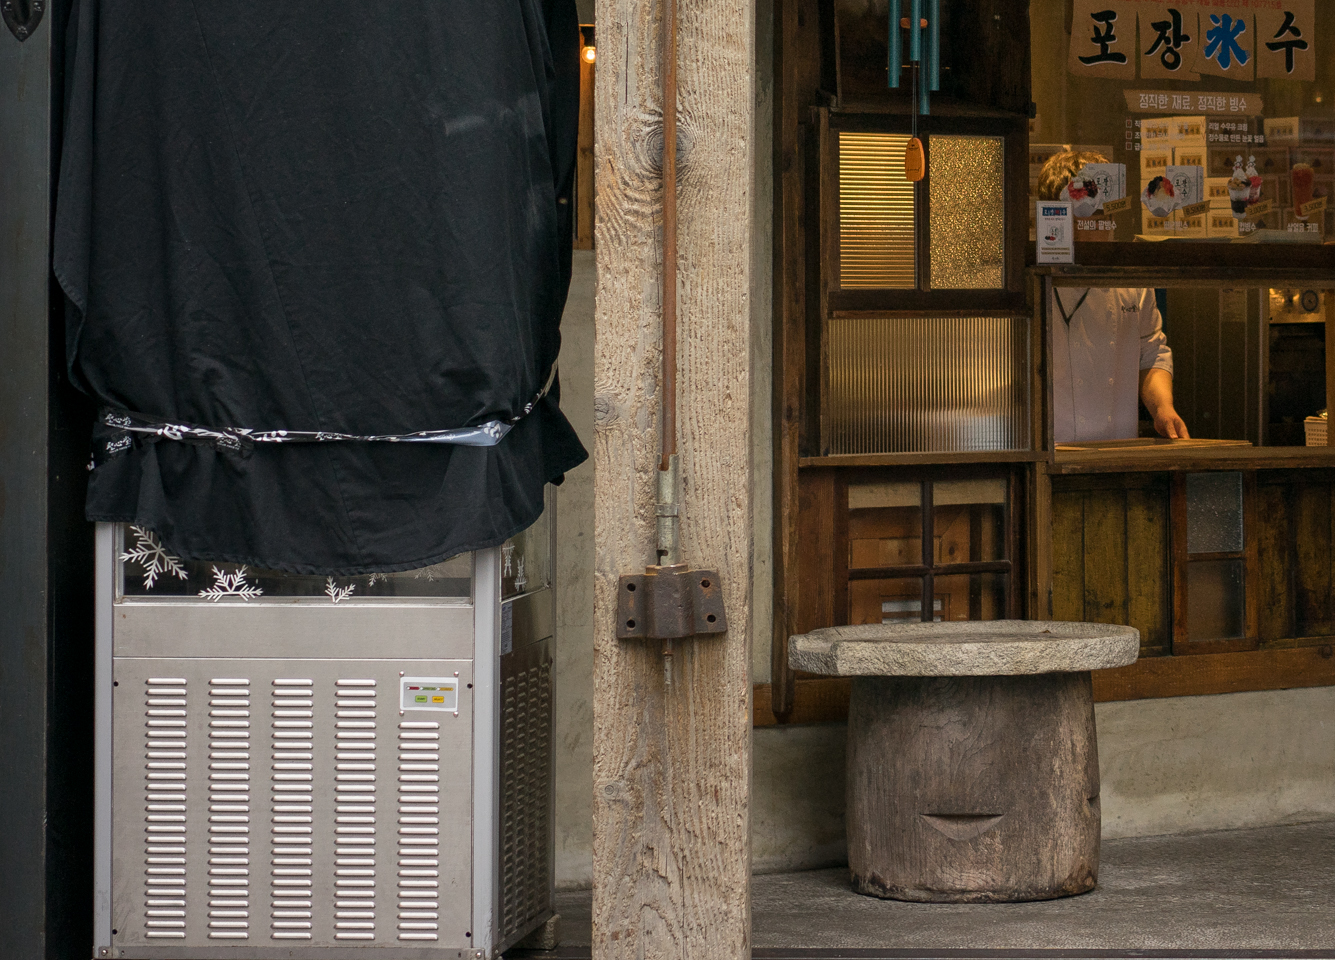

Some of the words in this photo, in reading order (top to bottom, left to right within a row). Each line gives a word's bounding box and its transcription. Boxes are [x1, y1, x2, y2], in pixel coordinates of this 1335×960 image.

[1139, 93, 1169, 109] 정직한
[1171, 94, 1195, 110] 재료,
[1197, 95, 1227, 111] 정직한
[1229, 97, 1247, 112] 빙수
[1077, 220, 1097, 230] 전설의
